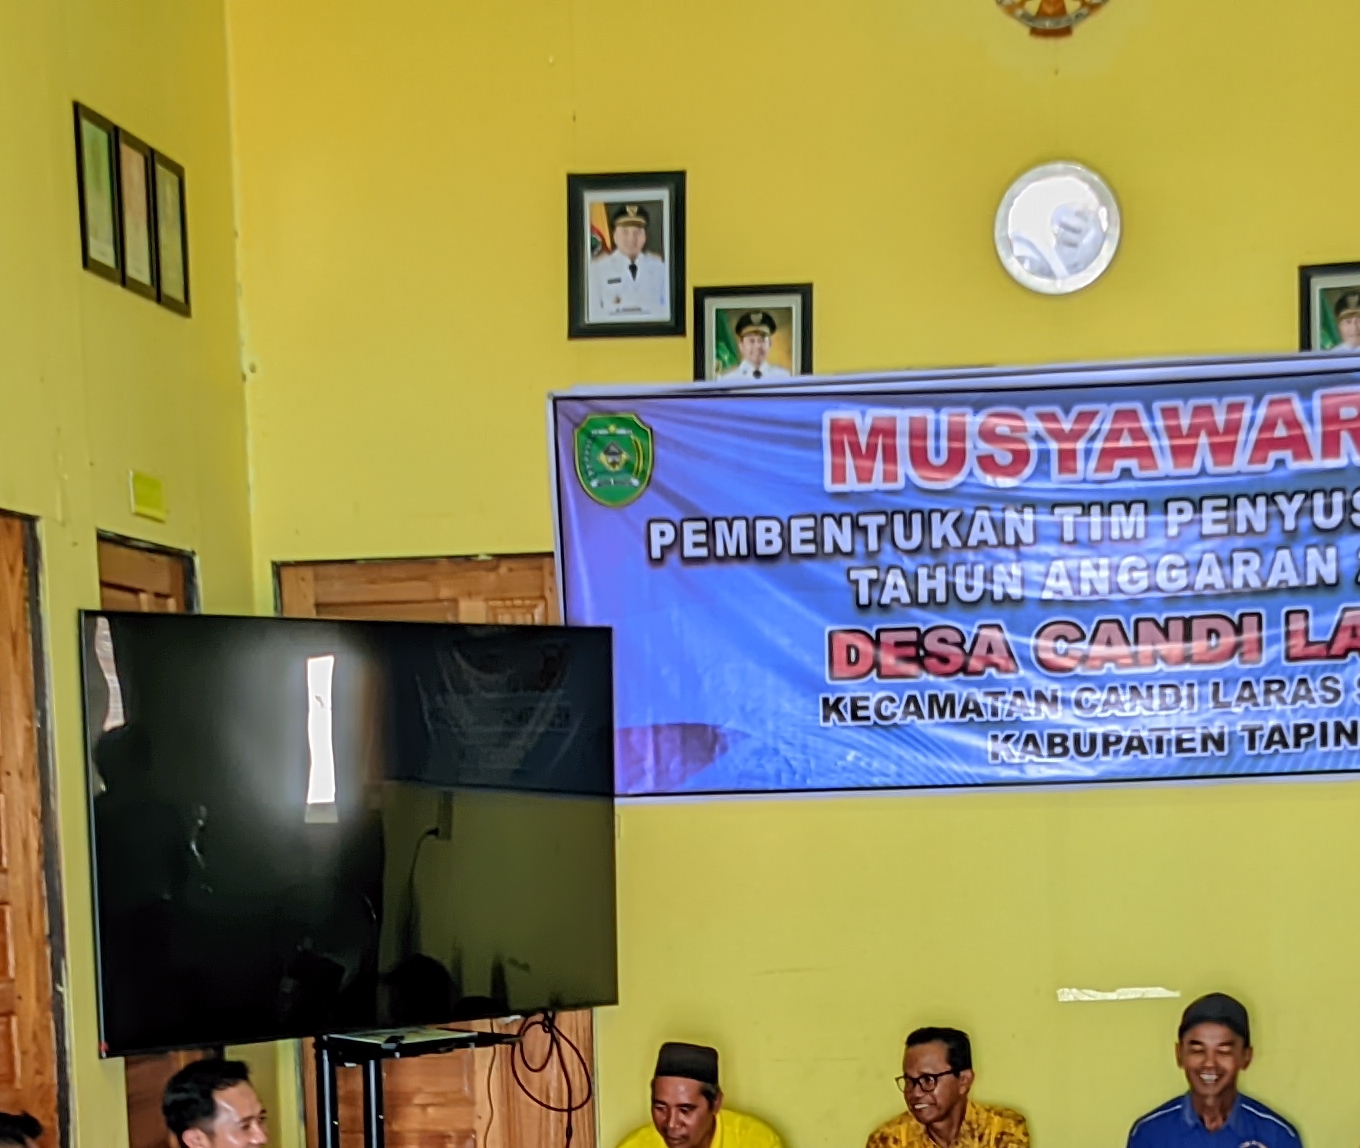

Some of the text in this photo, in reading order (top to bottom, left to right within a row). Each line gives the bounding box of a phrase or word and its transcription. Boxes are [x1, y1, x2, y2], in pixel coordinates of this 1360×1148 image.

[648, 507, 1035, 562] PEMBENTUKAN
[1053, 500, 1148, 544] TIM
[848, 562, 1024, 610] TAHUN
[1042, 545, 1338, 600] ANGGARAN
[827, 622, 1019, 684] DESA
[1034, 610, 1263, 674] CANDI
[820, 688, 1061, 727] KECAMATAN
[1070, 681, 1196, 717] CANDI
[1211, 674, 1341, 712] LARAS
[988, 725, 1227, 764] KABUPATEN
